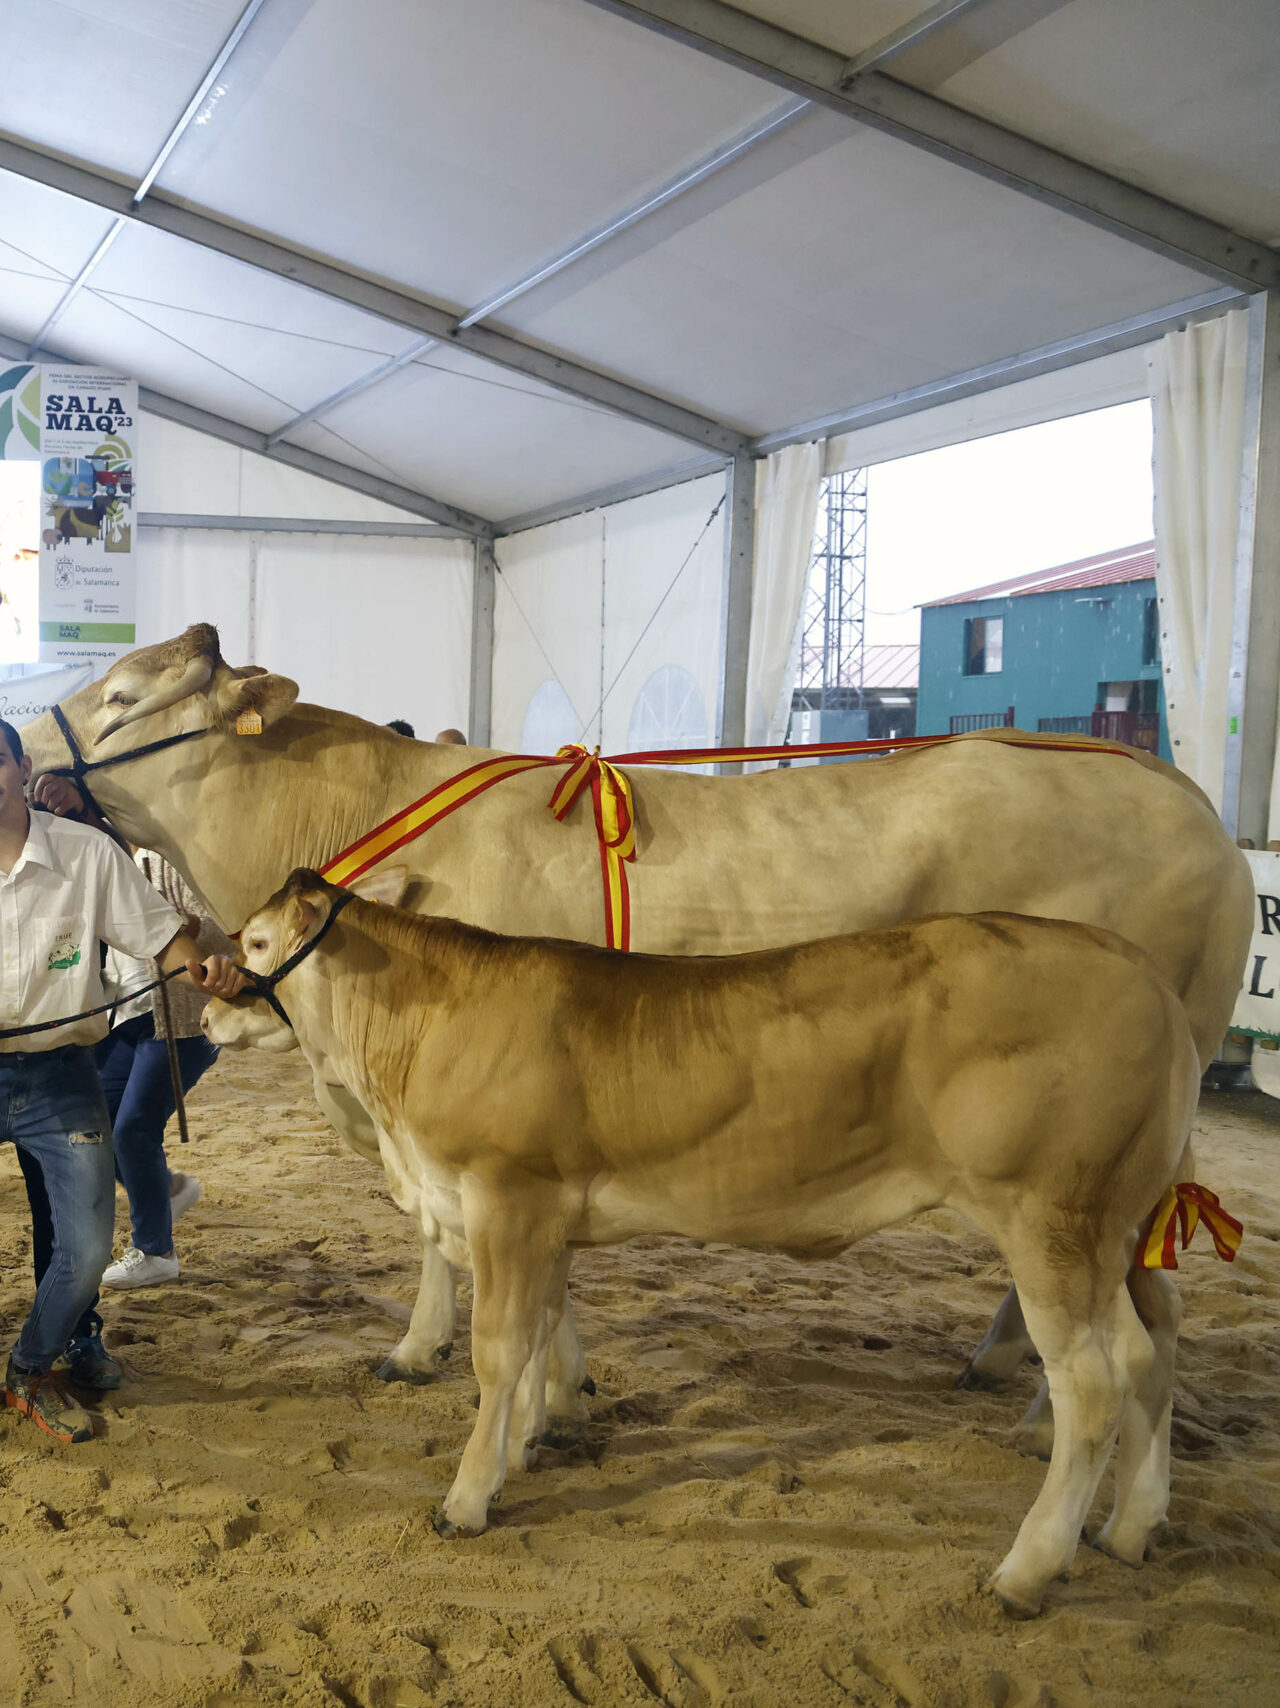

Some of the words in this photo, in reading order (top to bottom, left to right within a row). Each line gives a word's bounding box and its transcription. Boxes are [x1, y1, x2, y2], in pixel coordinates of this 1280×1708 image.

[46, 394, 126, 415] SALA
[46, 413, 117, 435] MAQ
[83, 578, 120, 587] Salamanca
